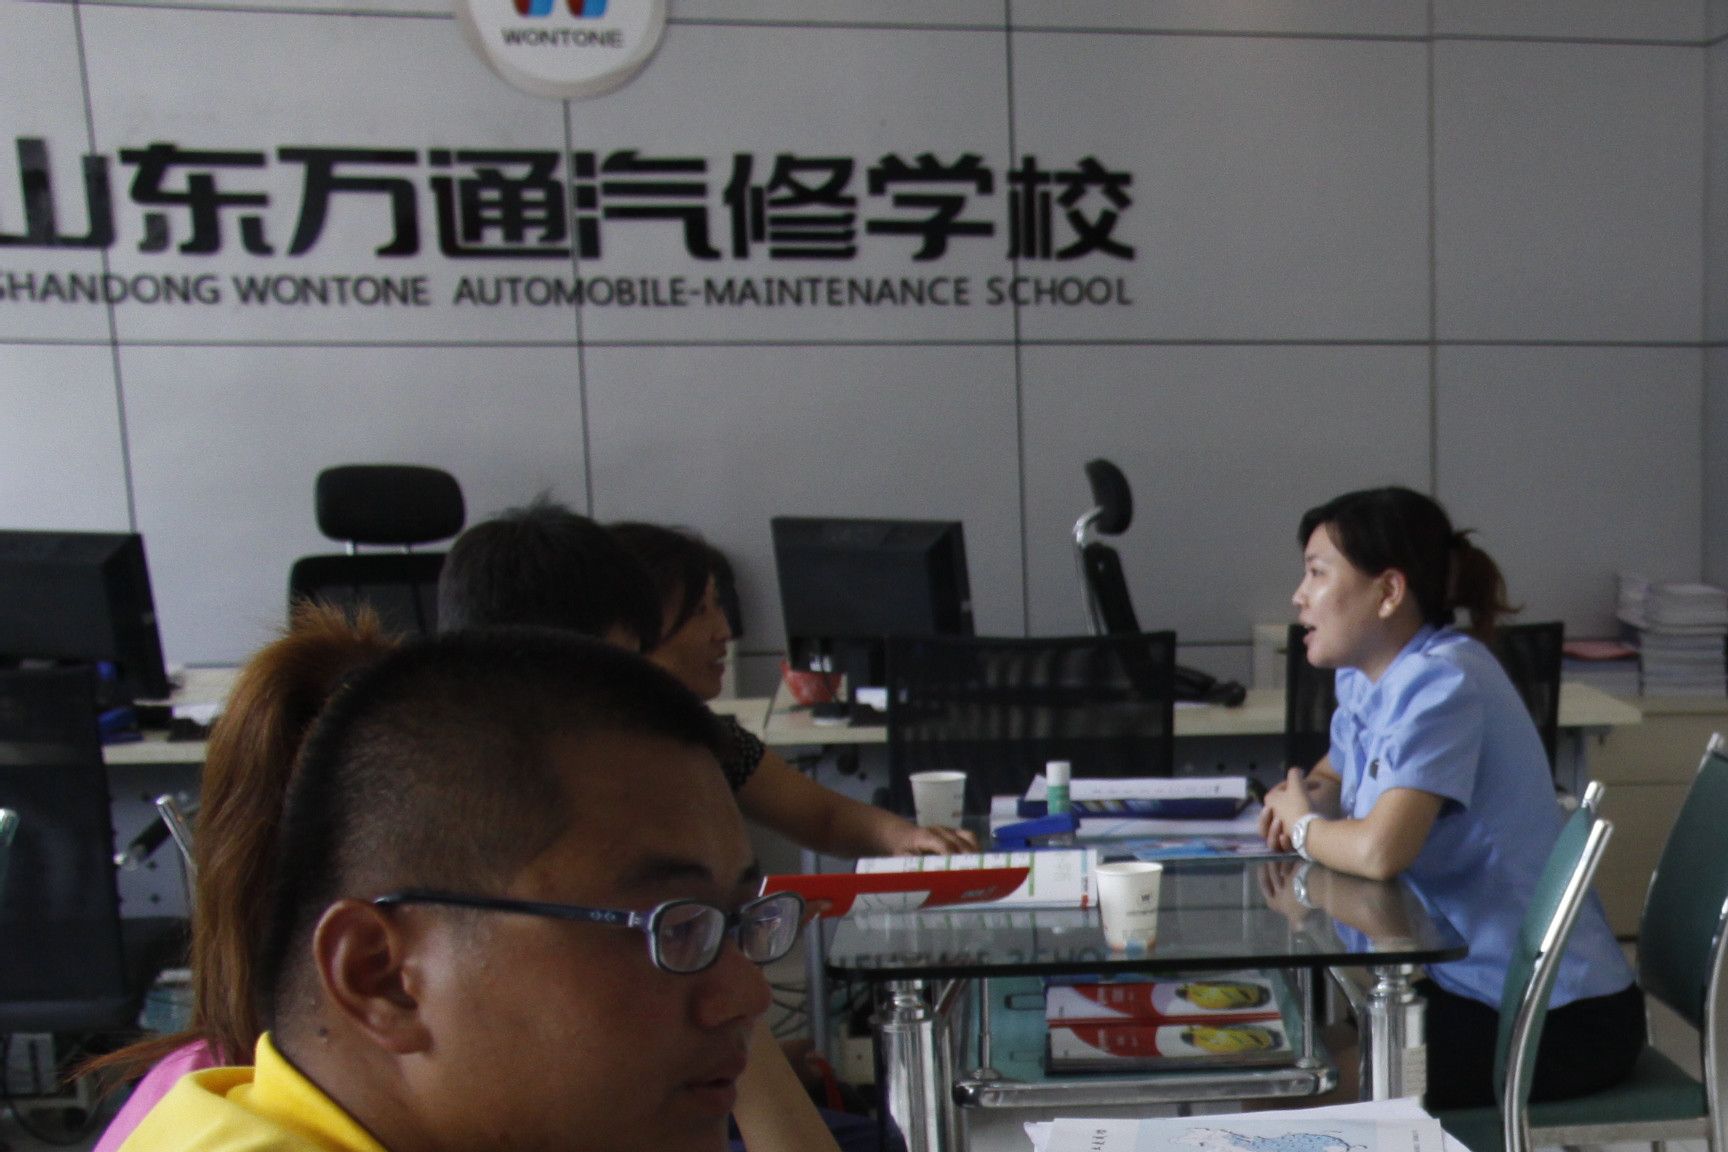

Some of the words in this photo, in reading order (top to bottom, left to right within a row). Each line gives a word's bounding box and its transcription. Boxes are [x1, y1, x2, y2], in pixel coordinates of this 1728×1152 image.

[503, 28, 623, 48] WONTONE
[0, 137, 1135, 260] 山东万通汽修学校
[233, 274, 429, 307] WONTONE
[454, 275, 970, 307] AUTOMOBILE-MAINTENANCE
[986, 276, 1134, 307] SCHOOL
